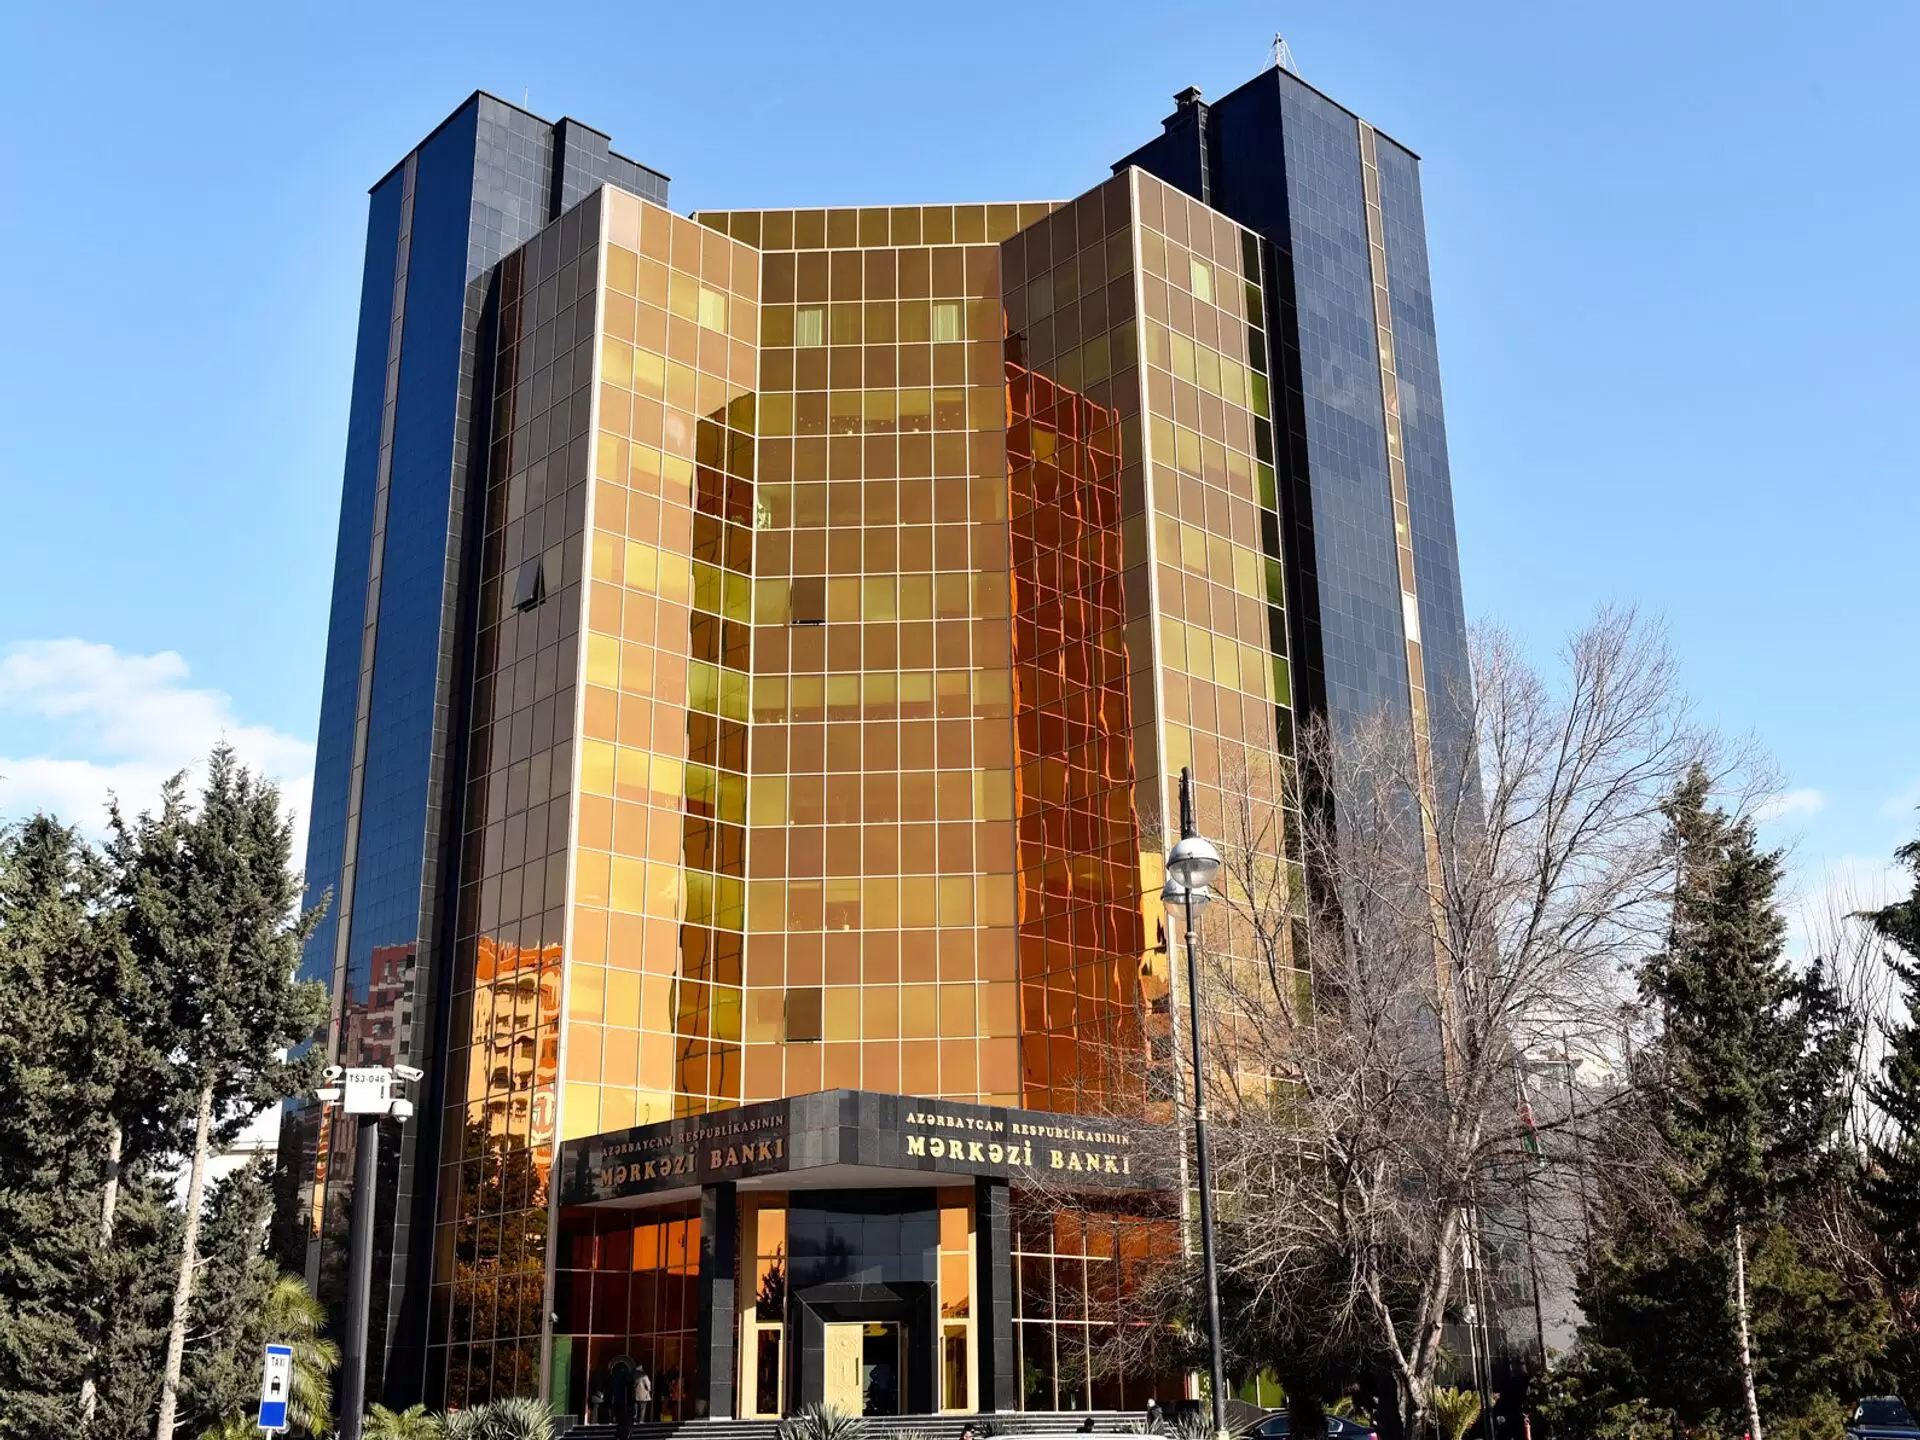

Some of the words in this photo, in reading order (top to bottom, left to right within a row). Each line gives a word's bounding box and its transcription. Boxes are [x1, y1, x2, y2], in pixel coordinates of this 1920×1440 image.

[906, 1112, 1004, 1133] AZƏRBAYCAN
[601, 1136, 672, 1157] AZƏRBAYCAN
[907, 1135, 1032, 1167] MƏRKƏZİ
[600, 1147, 696, 1187] MƏRKƏZİ
